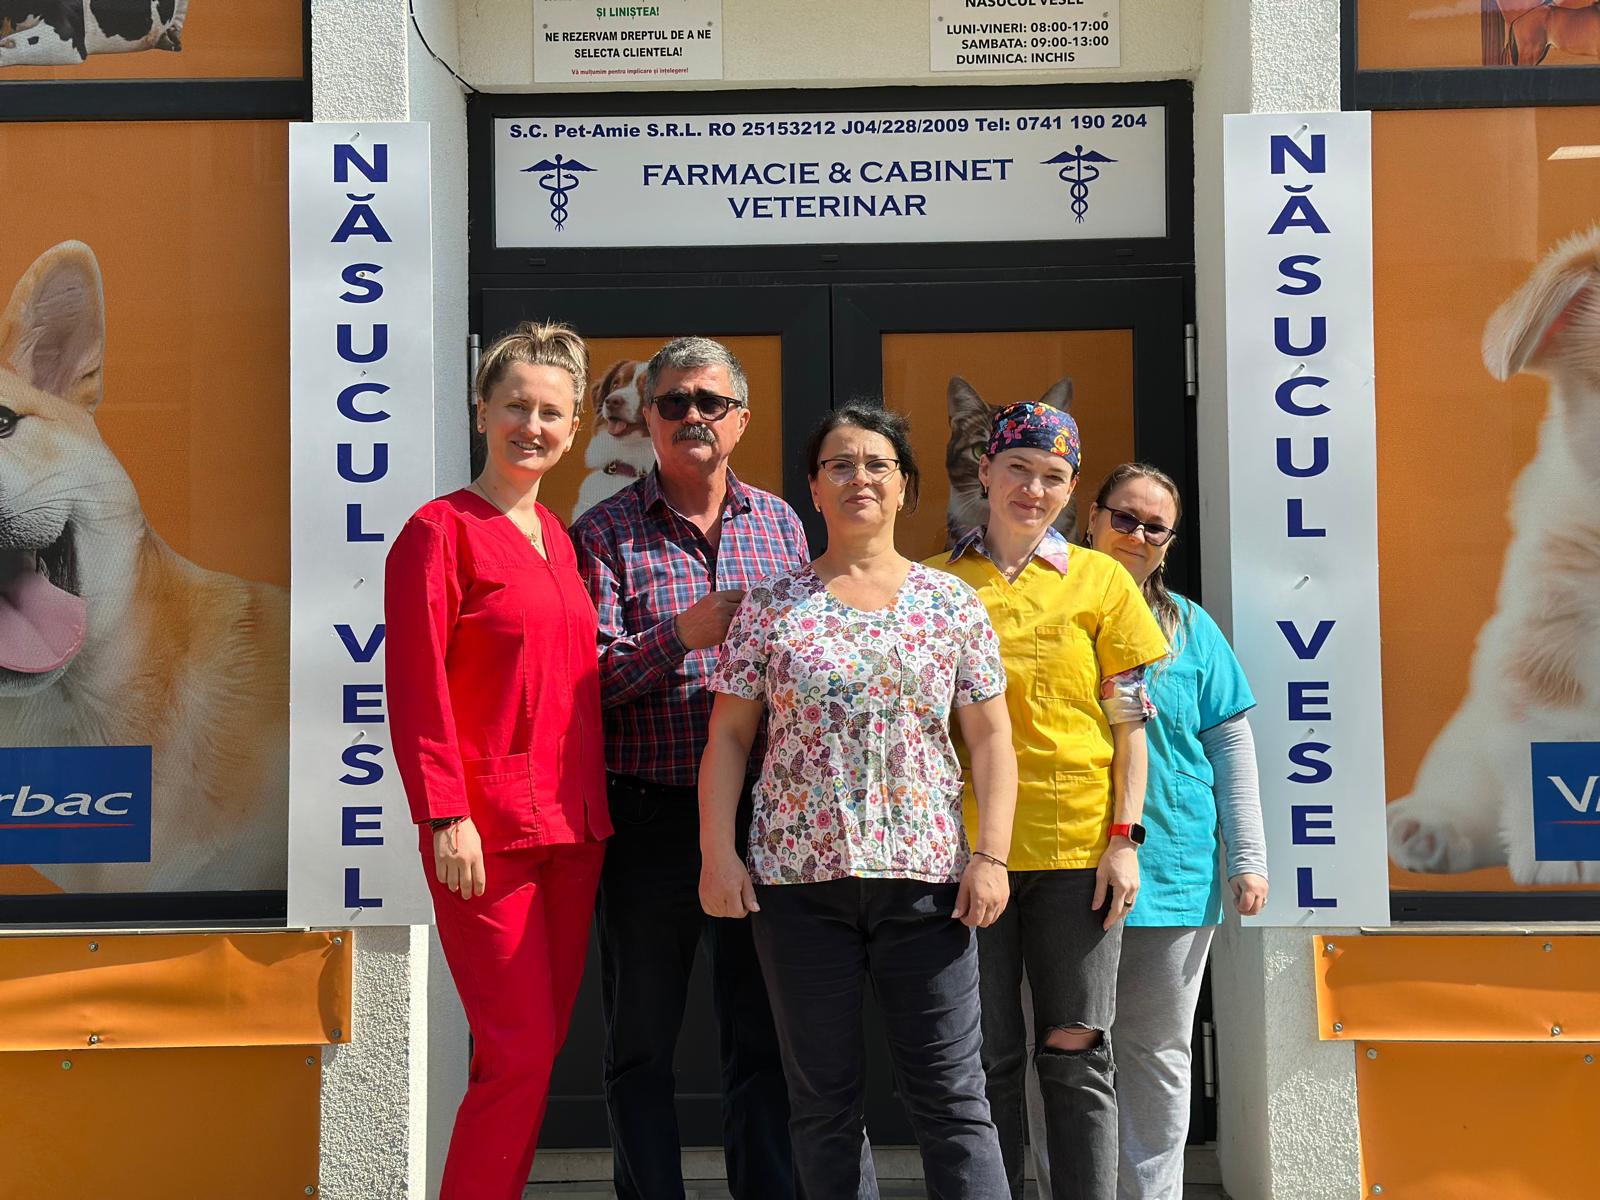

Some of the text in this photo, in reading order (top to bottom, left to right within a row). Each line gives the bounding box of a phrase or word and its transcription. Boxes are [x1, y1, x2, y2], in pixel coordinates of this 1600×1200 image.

[545, 29, 712, 42] NE REZERVAM DREPTUL DE A NE
[947, 21, 1108, 34] LUNI-VINERI: 08:00-17:00
[575, 47, 682, 58] SELECTA CLIENTELA!
[962, 36, 1108, 49] SAMBATA: 09:00-13:00
[957, 52, 1075, 64] DUMINICA: INCHIS
[510, 114, 1147, 138] S.C. Pet-Amie S.R.L. RO 25153212 J04/228/2009 Tel: 0741 190 204
[644, 158, 1013, 185] FARMACIE & CABINET
[728, 195, 926, 218] VETERINAR
[330, 143, 393, 908] NĂSUCUL VESEL
[1267, 134, 1338, 908] NĂSUCUL VESEL
[1546, 775, 1600, 813] V
